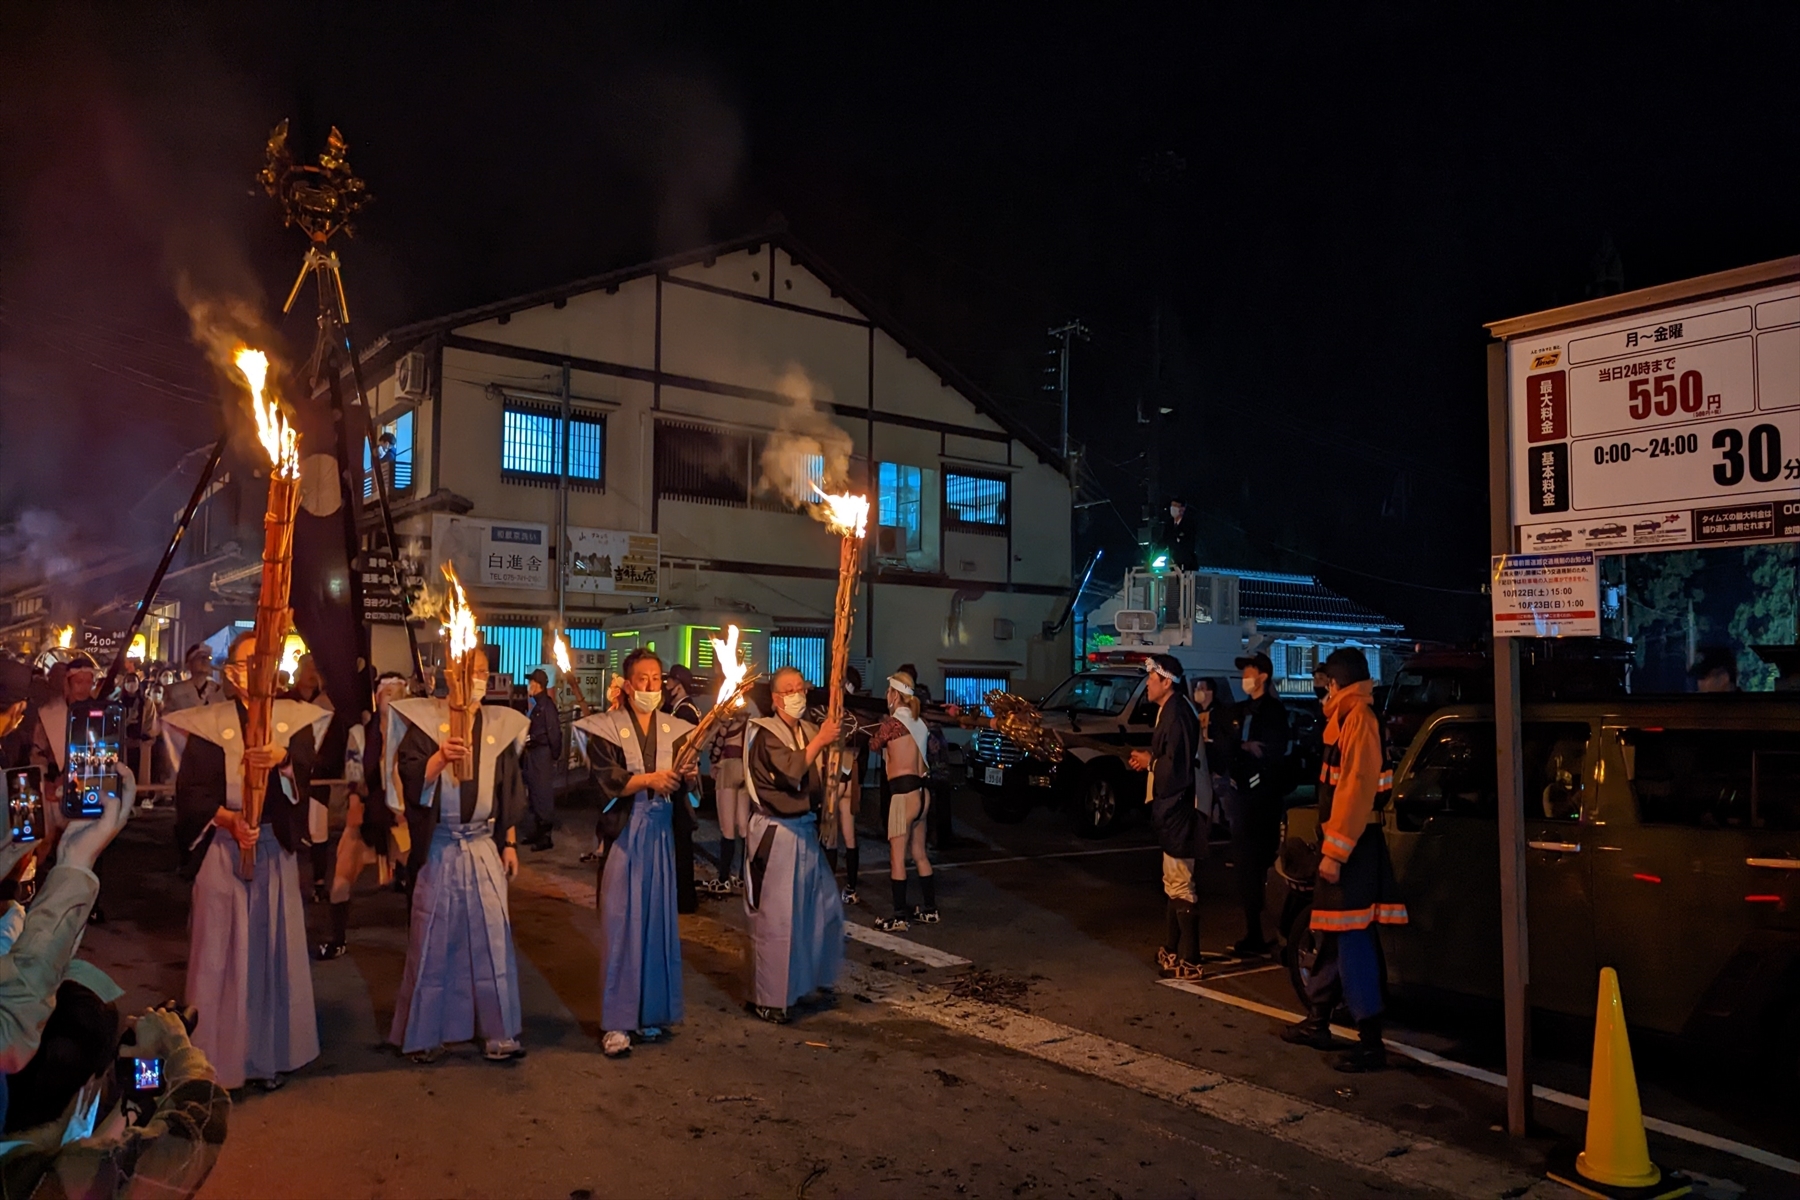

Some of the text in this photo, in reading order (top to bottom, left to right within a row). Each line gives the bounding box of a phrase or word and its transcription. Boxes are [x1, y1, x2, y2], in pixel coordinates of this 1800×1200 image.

[1598, 357, 1676, 382] 当日24時まで
[1539, 379, 1554, 434] 最大料金
[1541, 451, 1555, 507] 基本料金
[1702, 510, 1772, 523] タイムズの最大料金は
[1702, 521, 1772, 534] 繰り返し適用されます
[489, 552, 542, 571] 白進舎
